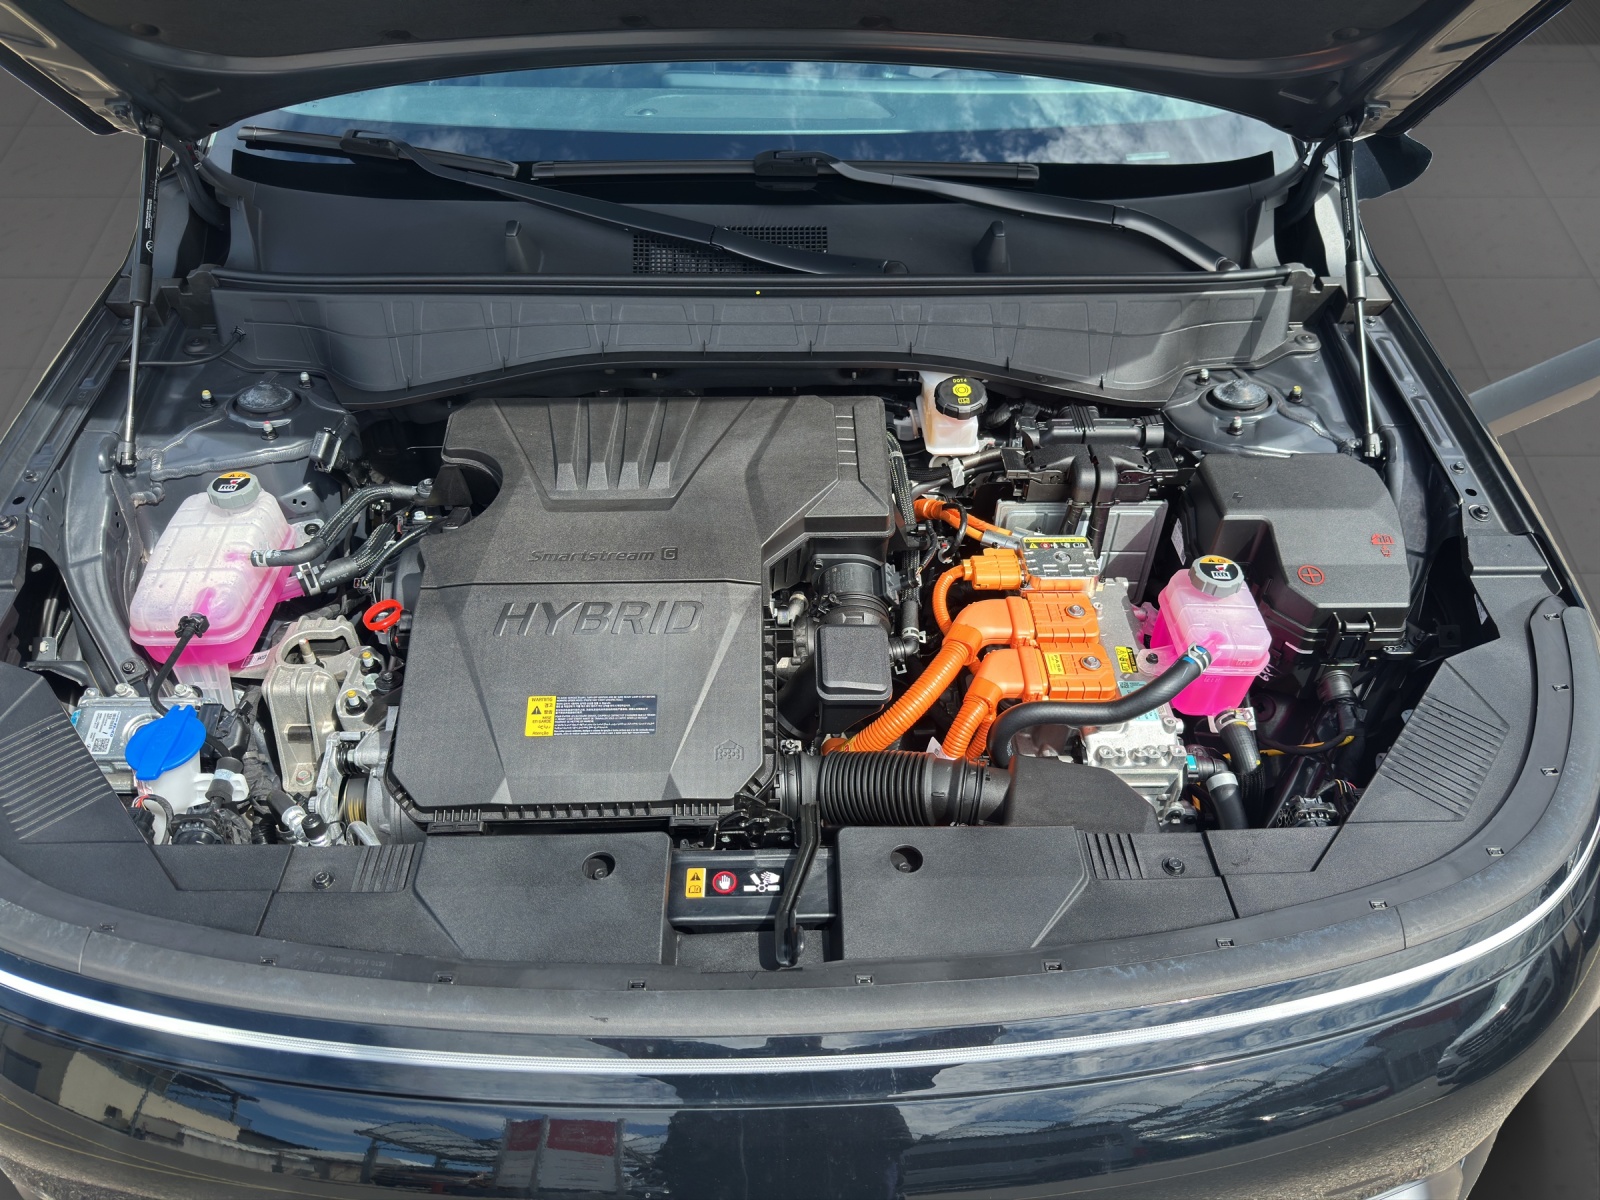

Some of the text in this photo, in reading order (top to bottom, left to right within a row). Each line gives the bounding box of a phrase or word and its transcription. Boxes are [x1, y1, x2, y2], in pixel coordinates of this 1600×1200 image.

[528, 547, 677, 562] Smartstream G
[493, 601, 704, 636] HYBRID
